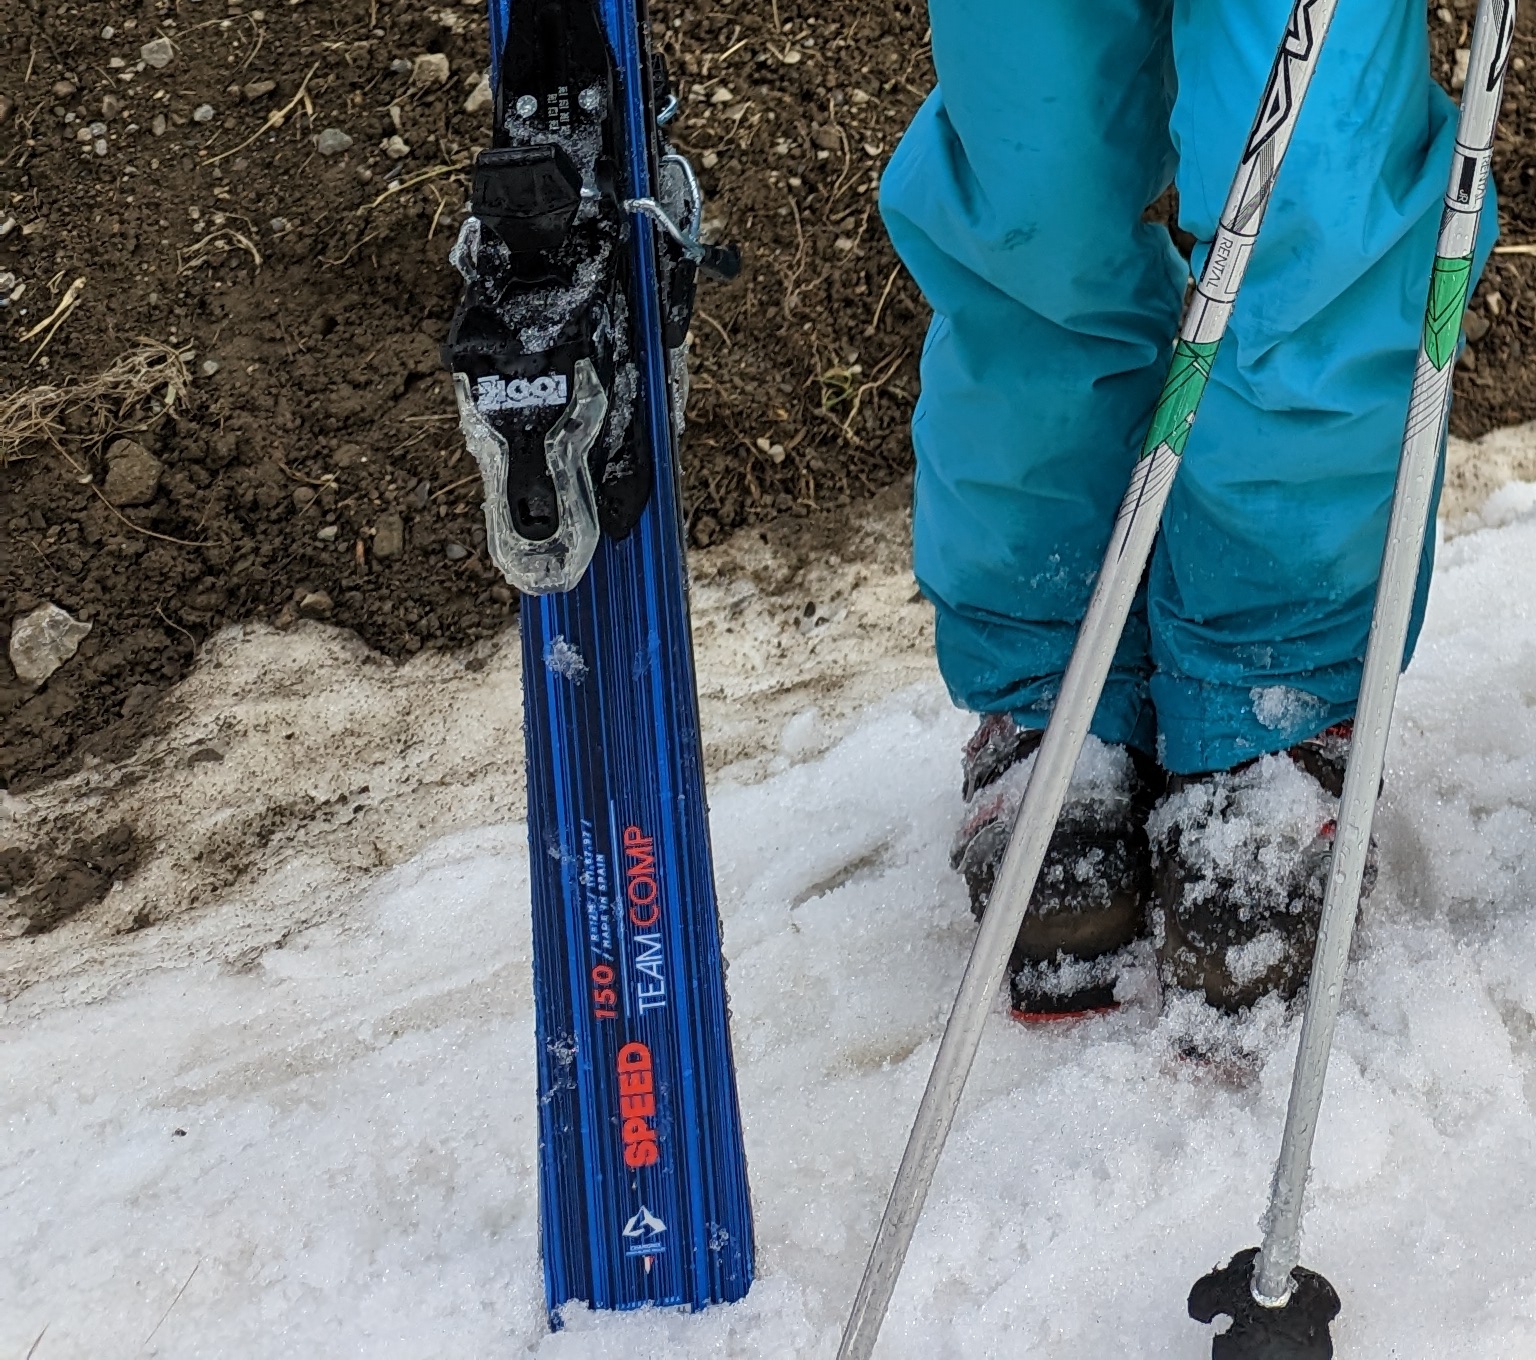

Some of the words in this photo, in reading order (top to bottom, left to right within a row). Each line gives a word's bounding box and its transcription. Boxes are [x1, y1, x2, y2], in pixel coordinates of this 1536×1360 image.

[1458, 188, 1469, 203] JR
[1475, 153, 1493, 204] RENTAL
[1206, 236, 1234, 289] RENTAL
[595, 853, 608, 892] SPAIN
[623, 824, 661, 928] COMP
[600, 914, 613, 950] MADE
[591, 963, 618, 1020] 150
[632, 931, 668, 1017] TEAM
[617, 1040, 660, 1169] SPEED
